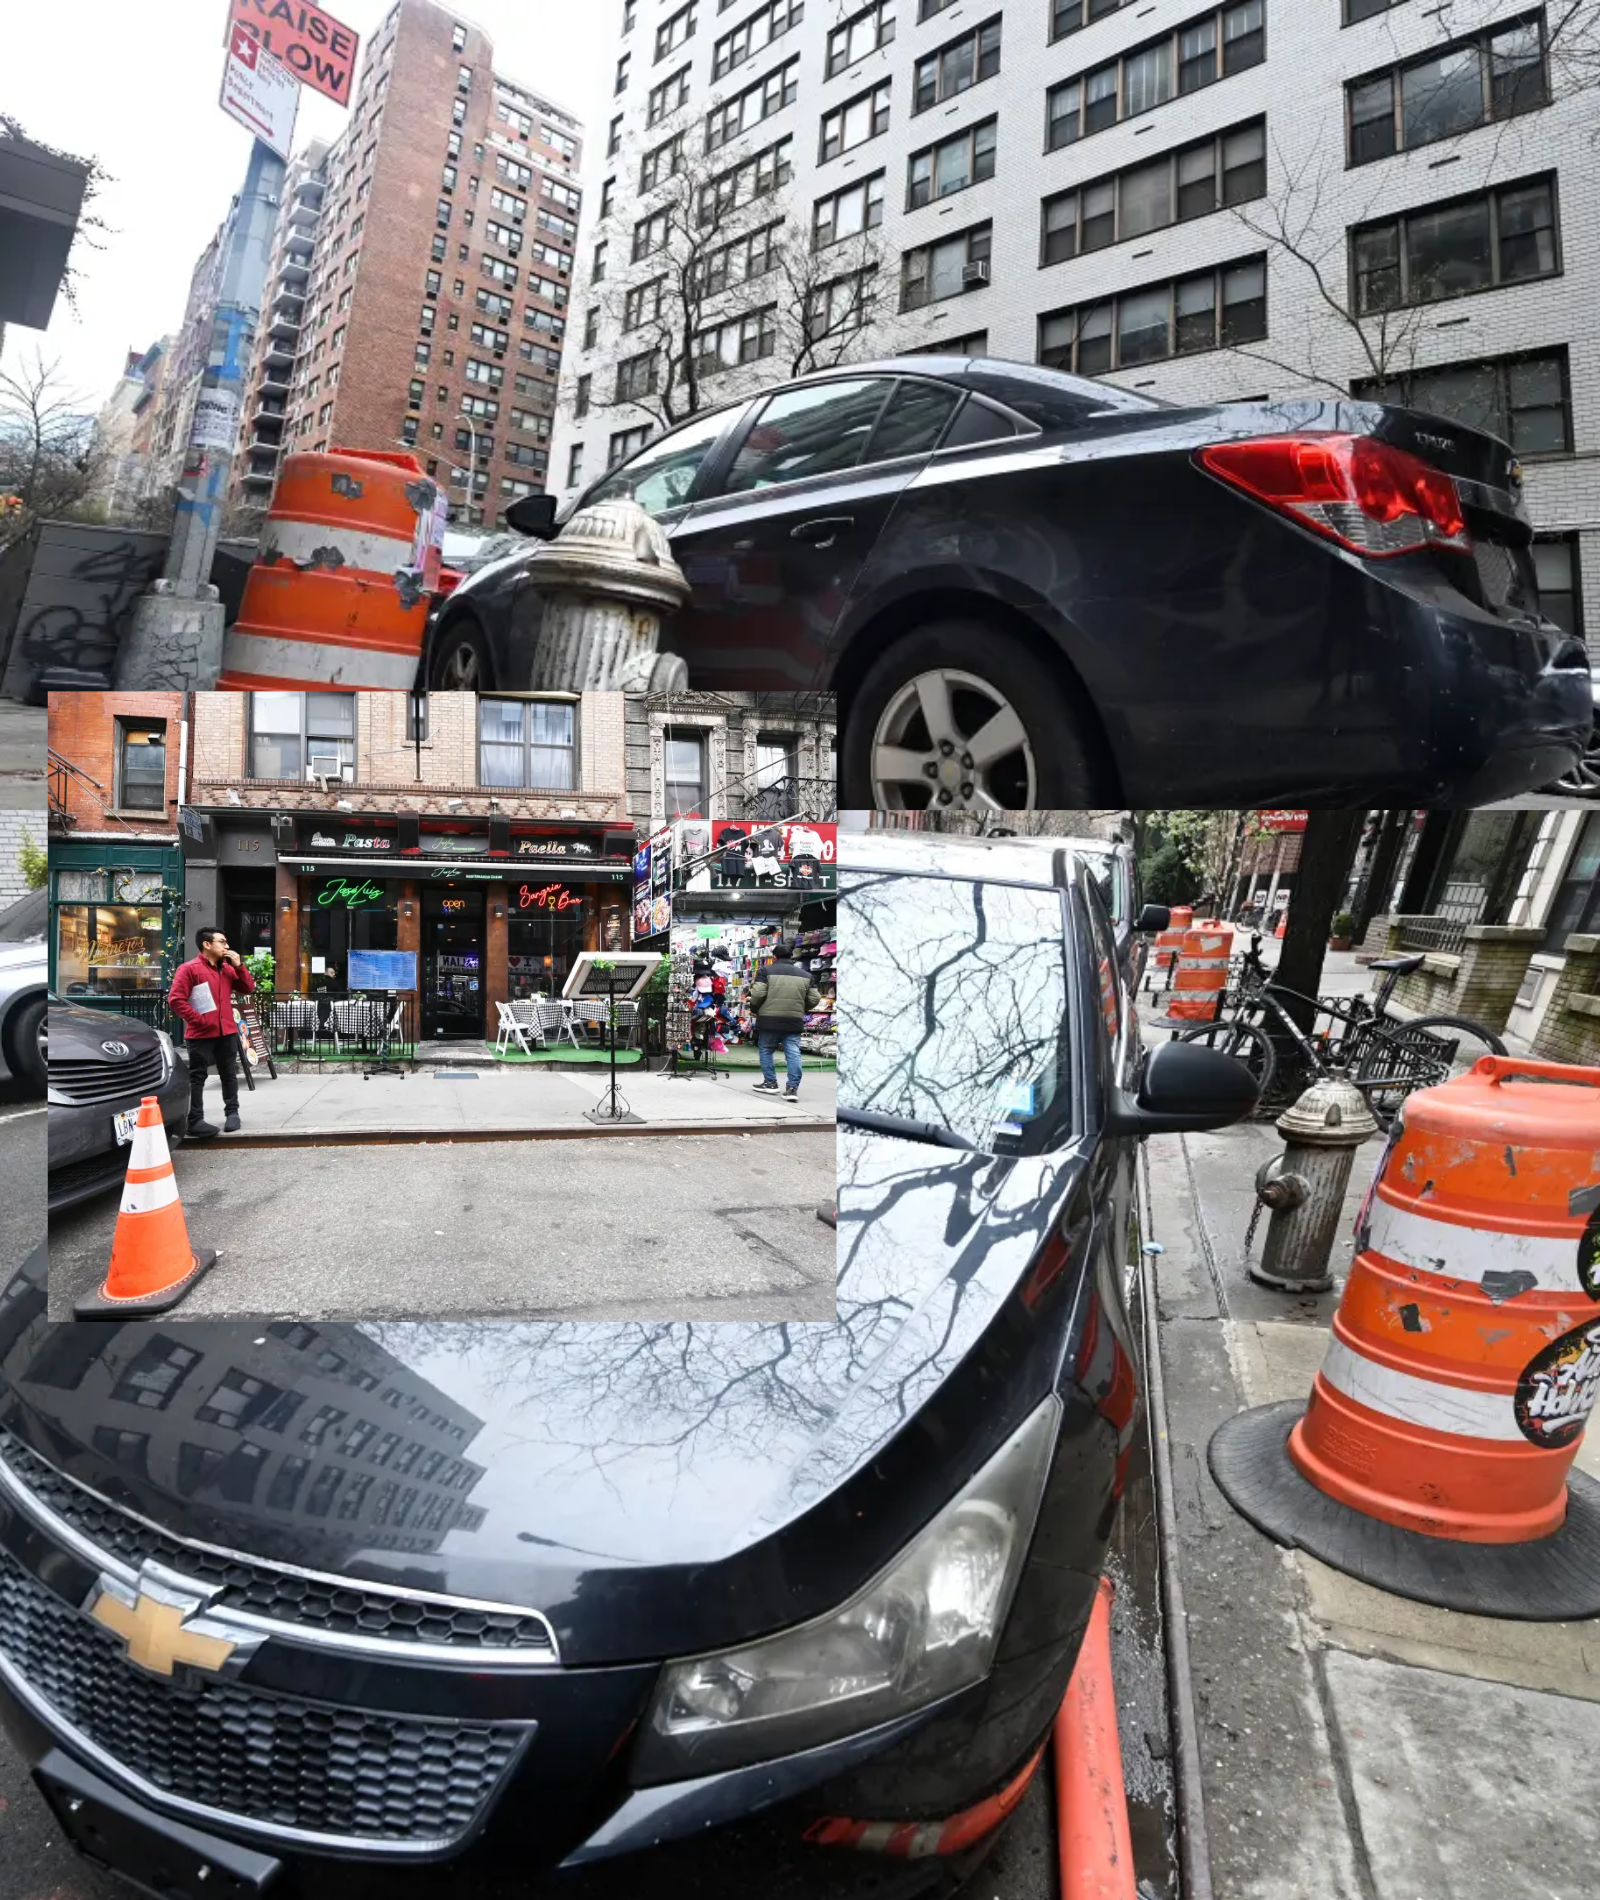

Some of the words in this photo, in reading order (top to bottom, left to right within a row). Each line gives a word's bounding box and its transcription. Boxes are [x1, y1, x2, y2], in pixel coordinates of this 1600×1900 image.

[237, 838, 259, 851] 115
[342, 833, 390, 849] Pasta
[518, 840, 567, 855] Paella
[519, 883, 562, 907] Sangria
[557, 890, 582, 909] Bar
[442, 899, 466, 909] open
[256, 915, 269, 925] 115
